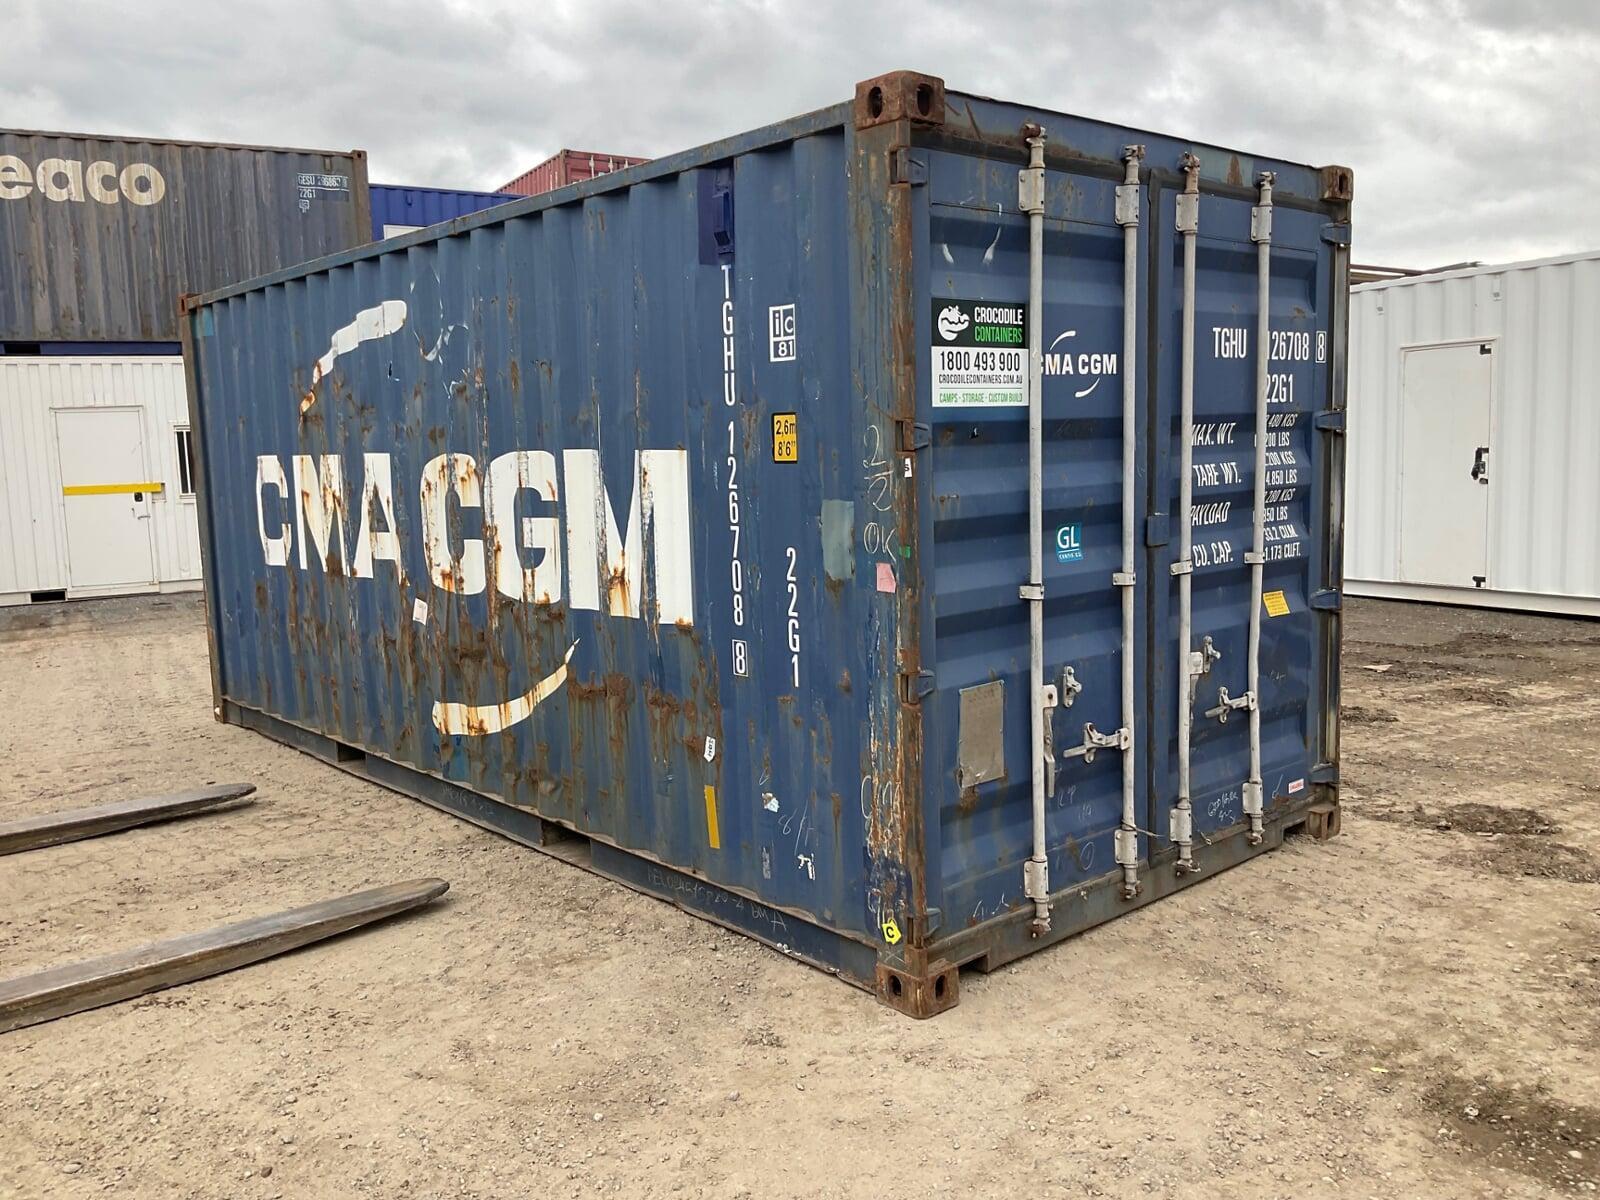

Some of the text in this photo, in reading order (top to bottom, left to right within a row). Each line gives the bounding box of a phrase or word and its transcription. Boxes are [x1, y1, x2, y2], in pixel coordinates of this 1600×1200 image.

[974, 306, 1023, 325] CROCODILE
[974, 325, 1023, 344] CONTAINERS
[1212, 327, 1247, 358] TGHU
[1317, 333, 1325, 361] 8
[778, 340, 793, 357] 81
[940, 351, 1020, 372] 1800 493 900
[1078, 353, 1117, 375] CGM
[938, 374, 1023, 384] CROCODILECONTAINERS.COM.AU
[1266, 374, 1294, 403] 22G1
[939, 393, 958, 403] CAMPS
[962, 393, 984, 403] STORAGE
[1216, 422, 1237, 445] WT.
[1278, 431, 1290, 447] LBS
[720, 264, 746, 674] TGHU 126708 8
[1192, 461, 1242, 487] TARE WT.
[1285, 468, 1298, 484] LBS
[1190, 501, 1231, 527] PAYLOAD
[1276, 505, 1289, 521] LBS
[255, 448, 695, 626] CMA CGM
[1057, 525, 1080, 549] GL
[1192, 540, 1234, 567] CU. CAP.
[785, 546, 800, 688] 22G1
